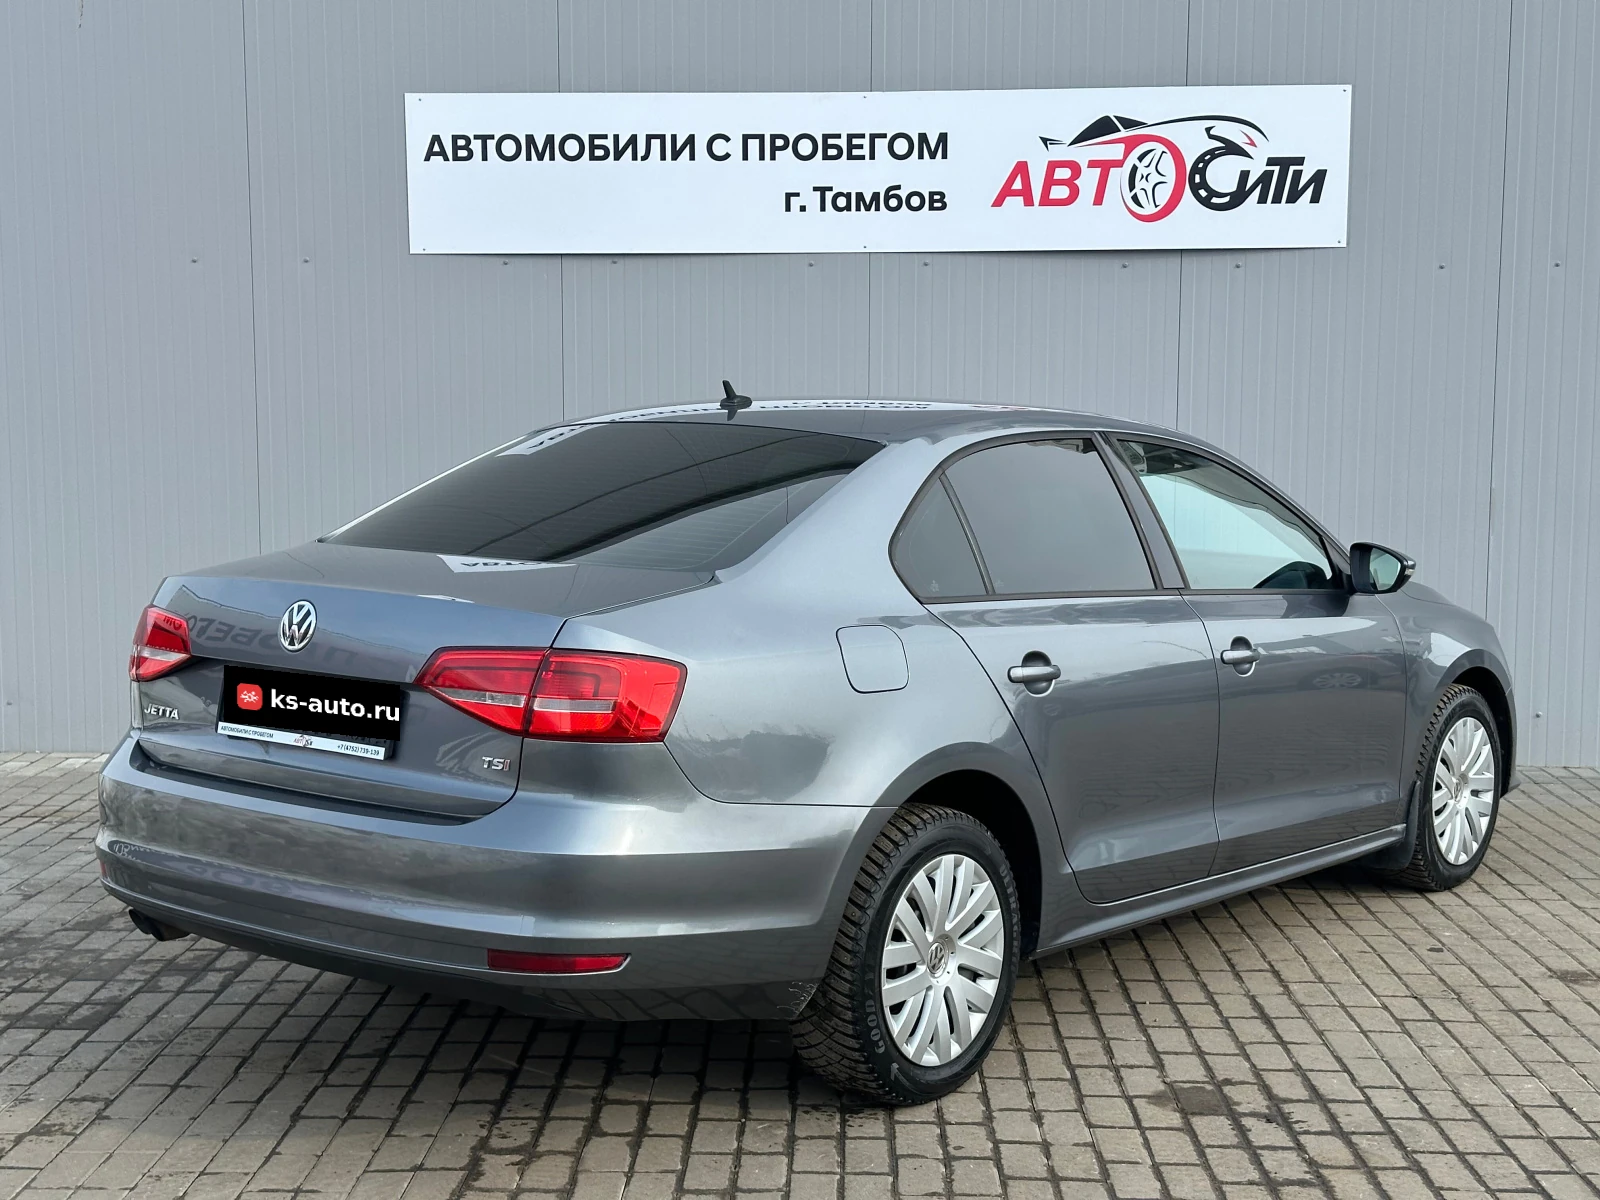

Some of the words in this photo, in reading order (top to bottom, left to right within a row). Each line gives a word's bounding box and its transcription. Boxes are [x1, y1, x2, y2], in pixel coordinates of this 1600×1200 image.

[423, 133, 696, 162] АВТОМОБИЛИ
[706, 133, 732, 162] С
[741, 131, 948, 162] ПРОБЕГОМ
[813, 184, 948, 213] Тамбов
[144, 703, 179, 720] JETTA
[481, 756, 511, 772] TSI
